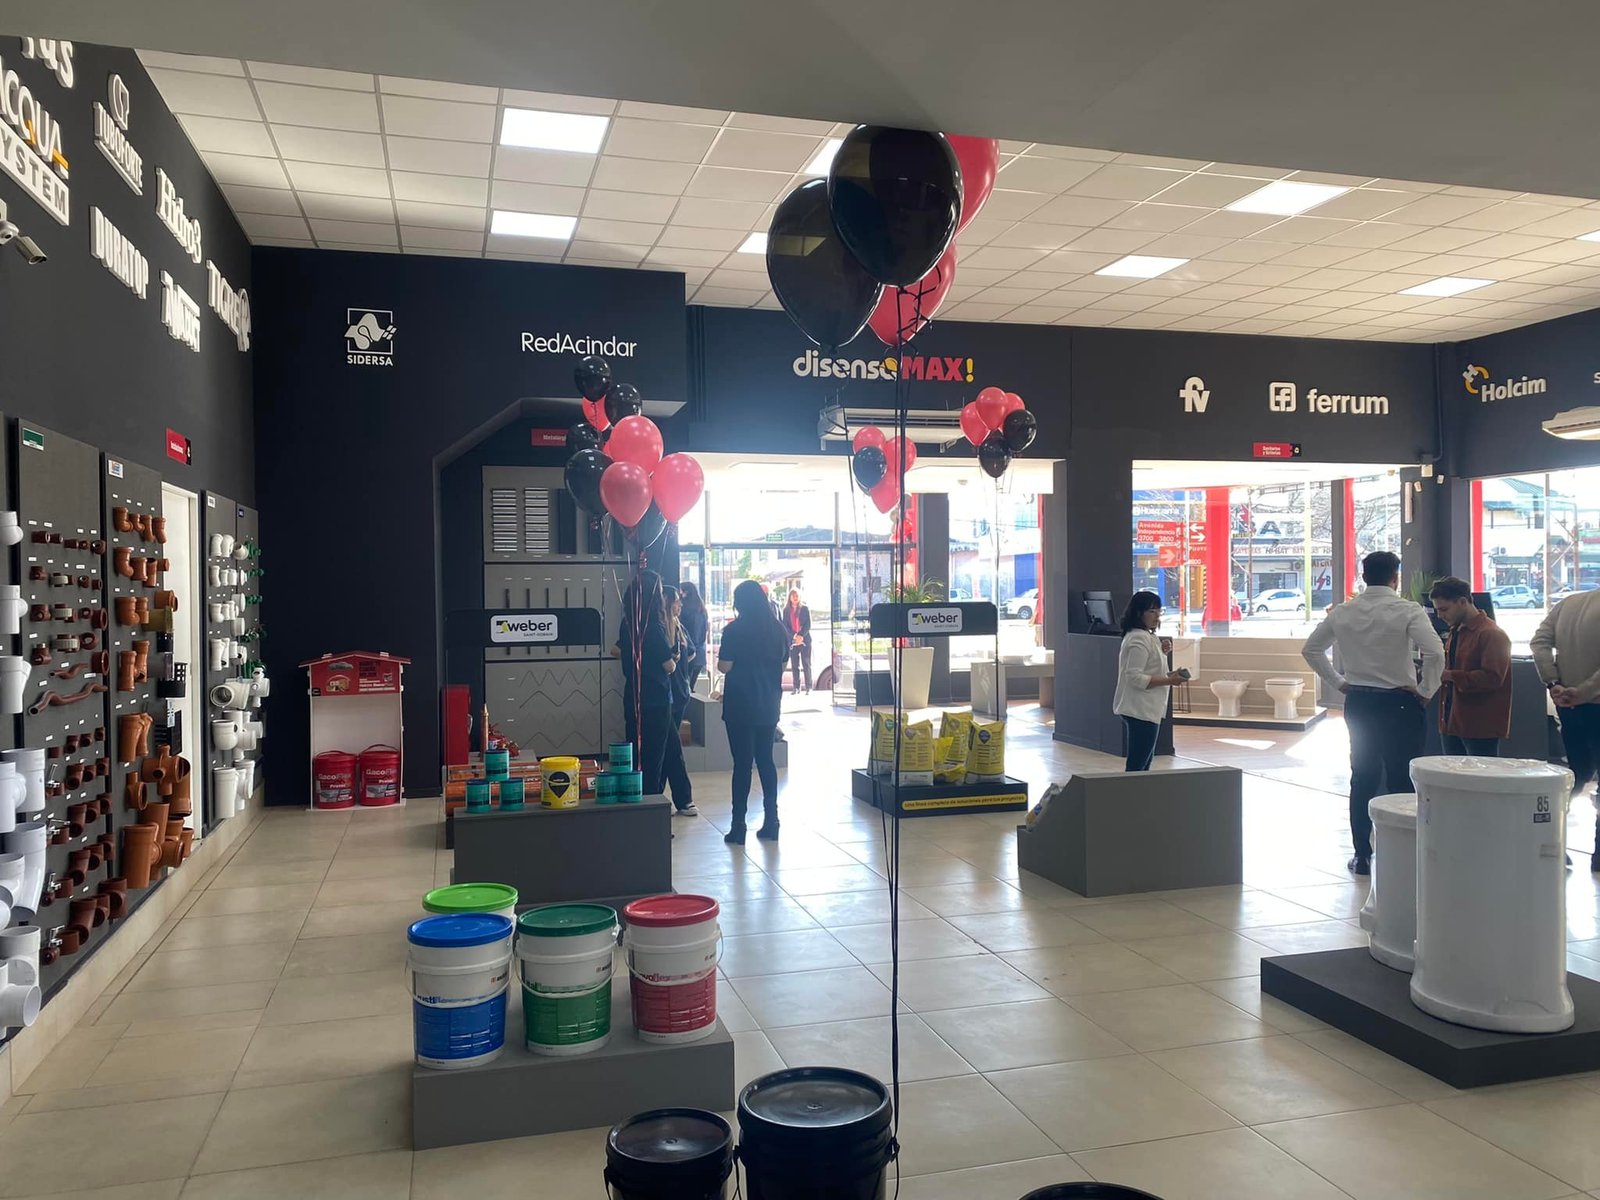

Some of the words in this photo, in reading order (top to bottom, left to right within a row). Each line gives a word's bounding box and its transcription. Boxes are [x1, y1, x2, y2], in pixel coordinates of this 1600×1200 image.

[0, 56, 69, 180] CQUA
[90, 206, 149, 300] DURATOP
[521, 332, 638, 357] RedAcindar
[347, 354, 394, 366] SIDERSA
[1306, 388, 1389, 414] ferrum
[1481, 376, 1547, 402] Holcim
[507, 619, 553, 632] weber
[922, 612, 959, 624] weber
[1537, 796, 1549, 812] 85
